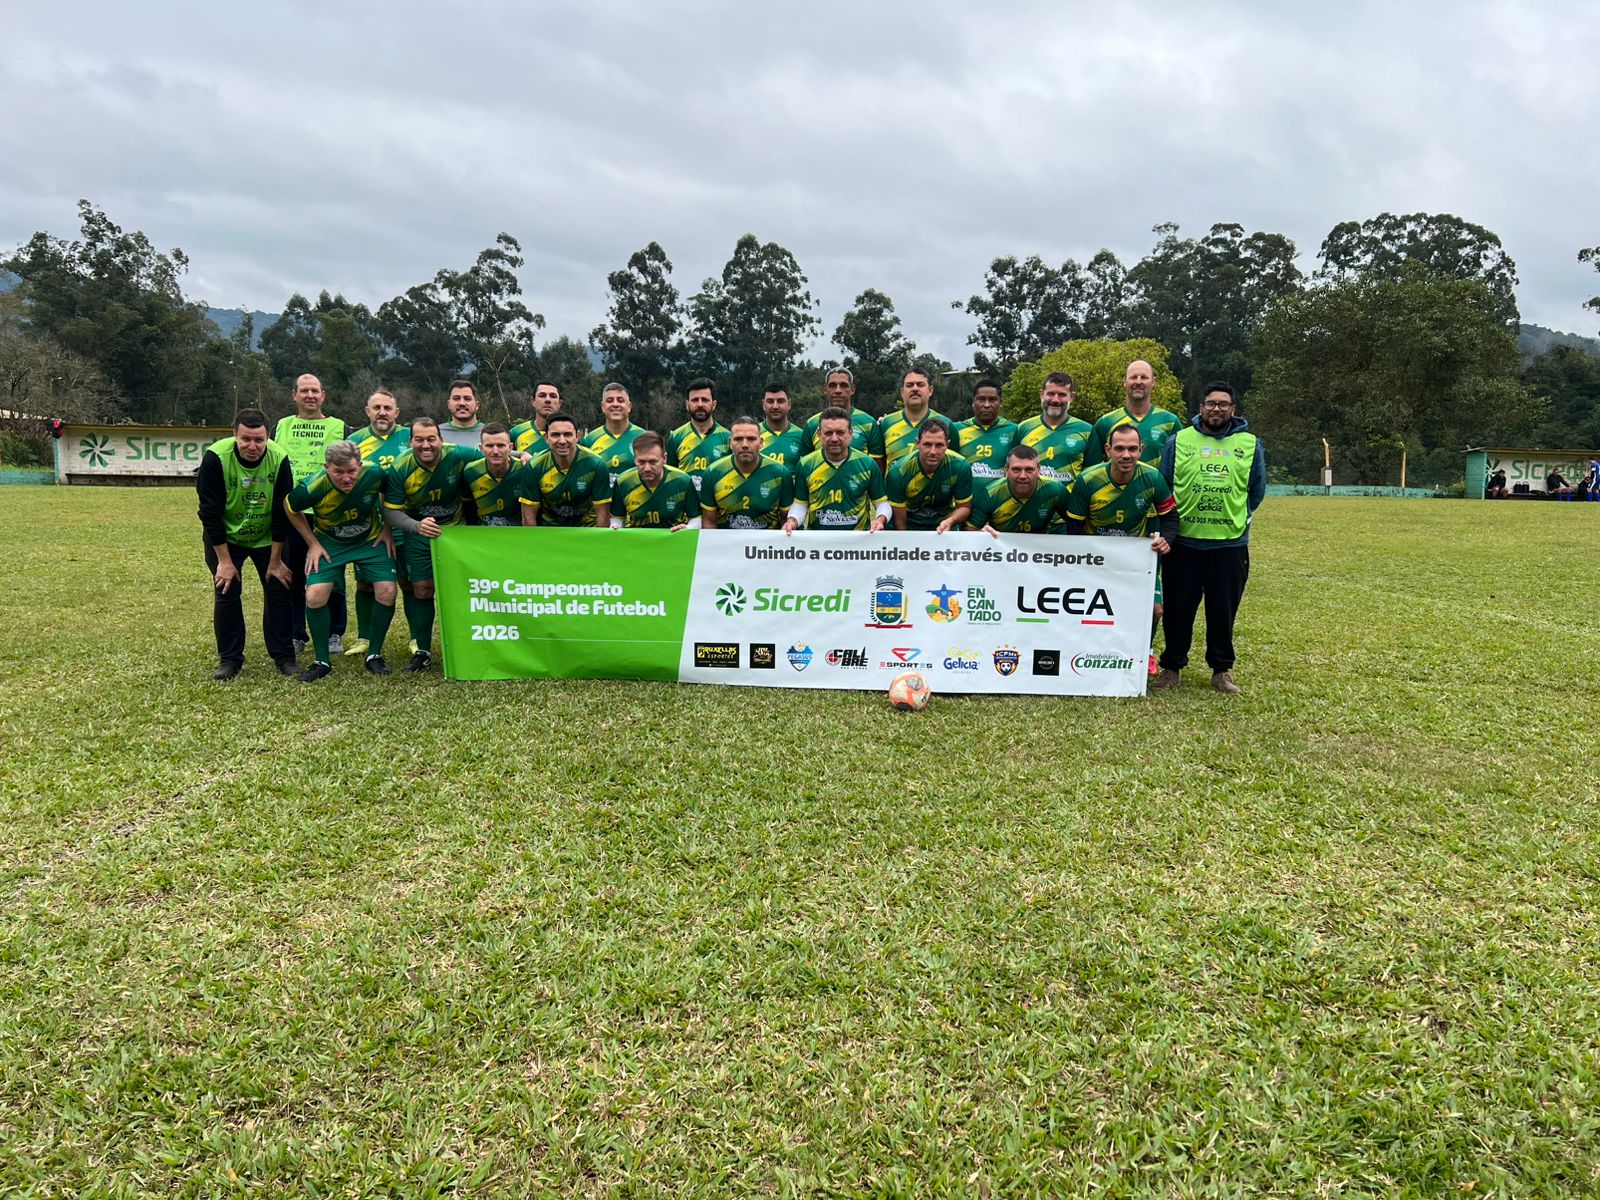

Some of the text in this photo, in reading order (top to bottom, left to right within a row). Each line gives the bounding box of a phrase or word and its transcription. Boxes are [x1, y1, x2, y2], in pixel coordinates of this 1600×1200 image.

[125, 436, 210, 461] Sicre
[976, 445, 992, 457] 25
[1046, 446, 1054, 460] 4
[611, 454, 619, 467] 6
[694, 457, 707, 471] 20
[1200, 464, 1229, 473] LEEA
[428, 489, 441, 501] 17
[1203, 485, 1232, 493] Sicredi
[742, 496, 750, 509] 2
[829, 489, 843, 503] 14
[496, 498, 504, 511] 8
[343, 508, 358, 520] 15
[647, 511, 660, 524] 10
[1115, 510, 1125, 524] 5
[744, 546, 1105, 567] Unindo a comunidade através do esporte
[502, 579, 623, 599] Campeonato
[967, 588, 986, 598] EN
[752, 588, 851, 612] Sicredi
[967, 599, 995, 610] CAN
[1017, 586, 1114, 616] LEEA
[470, 597, 667, 618] Municipal de Futebol
[967, 610, 1002, 621] TADO
[471, 625, 520, 640] 2026
[1074, 657, 1134, 670] Conzatti
